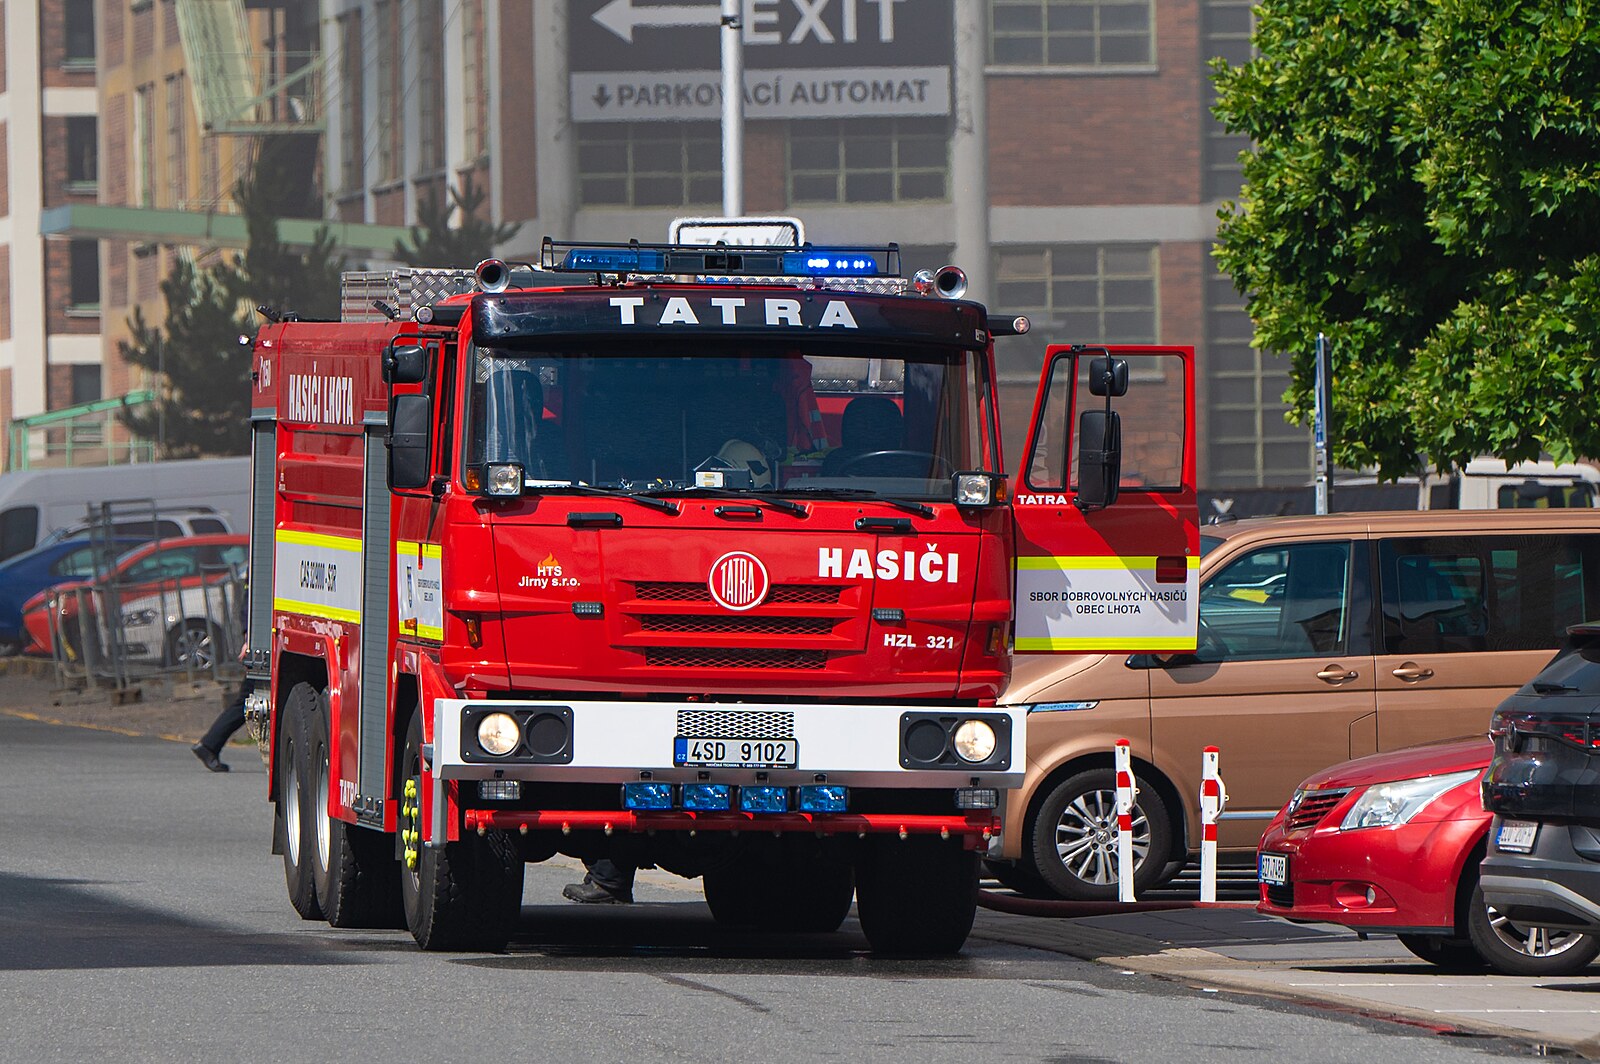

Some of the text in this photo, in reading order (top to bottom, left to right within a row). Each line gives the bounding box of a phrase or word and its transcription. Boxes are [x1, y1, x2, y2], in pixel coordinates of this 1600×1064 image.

[742, 0, 905, 44] EXIT
[791, 79, 930, 106] AUTOMAT
[609, 296, 859, 329] TATRA
[323, 376, 354, 425] LHOTA
[1017, 494, 1068, 505] TATRA
[537, 565, 563, 577] HTS
[818, 542, 959, 584] HASIČI
[518, 575, 581, 589] Jirny s.r.o.
[720, 557, 755, 605] TATRA
[1029, 589, 1187, 602] SBOR DOBROVOLNÝCH HASIČŮ
[1076, 604, 1141, 615] OBEC LHOTA
[883, 633, 954, 649] HZL 321
[691, 741, 726, 761] 4SD
[741, 742, 787, 762] 9102
[339, 779, 358, 807] TATR
